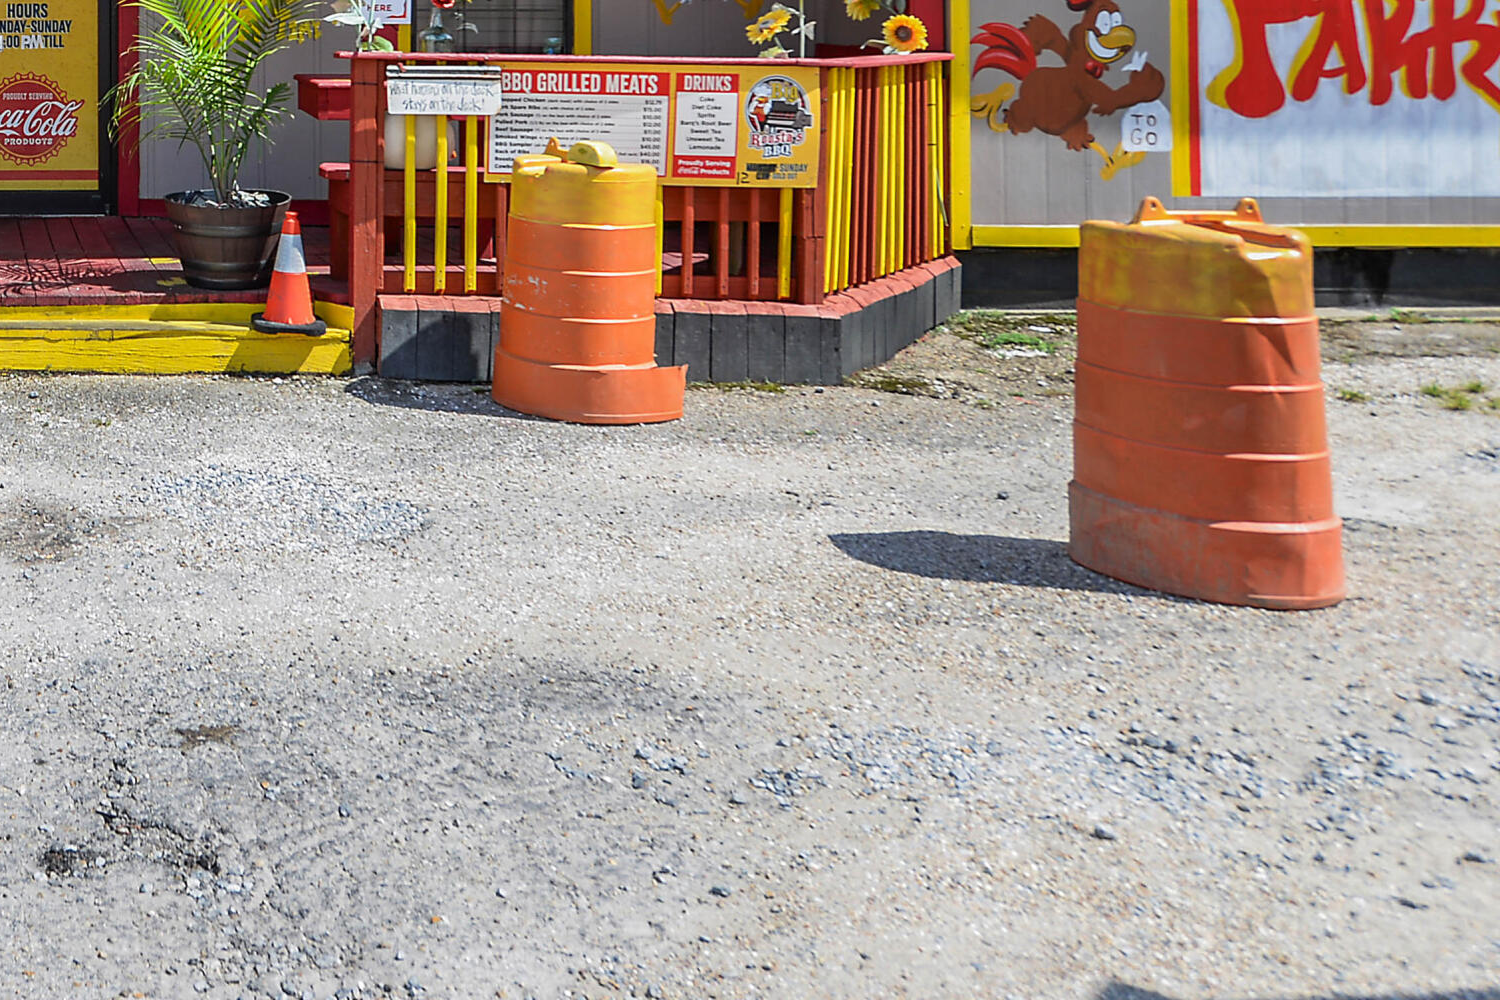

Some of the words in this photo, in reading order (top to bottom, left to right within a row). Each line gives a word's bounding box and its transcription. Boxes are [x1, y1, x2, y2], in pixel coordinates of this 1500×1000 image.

[7, 4, 48, 18] HOURS
[44, 35, 65, 48] TILL
[502, 72, 532, 94] BBQ
[536, 73, 601, 92] GRILLED
[606, 75, 659, 94] MEATS
[683, 74, 732, 91] DRINKS
[3, 92, 27, 100] PROUDLY
[29, 92, 53, 100] SERVING
[771, 81, 799, 102] Big
[1130, 113, 1158, 129] TO
[749, 131, 803, 147] Roosta's
[1130, 129, 1158, 146] GO
[763, 145, 792, 158] BBQ
